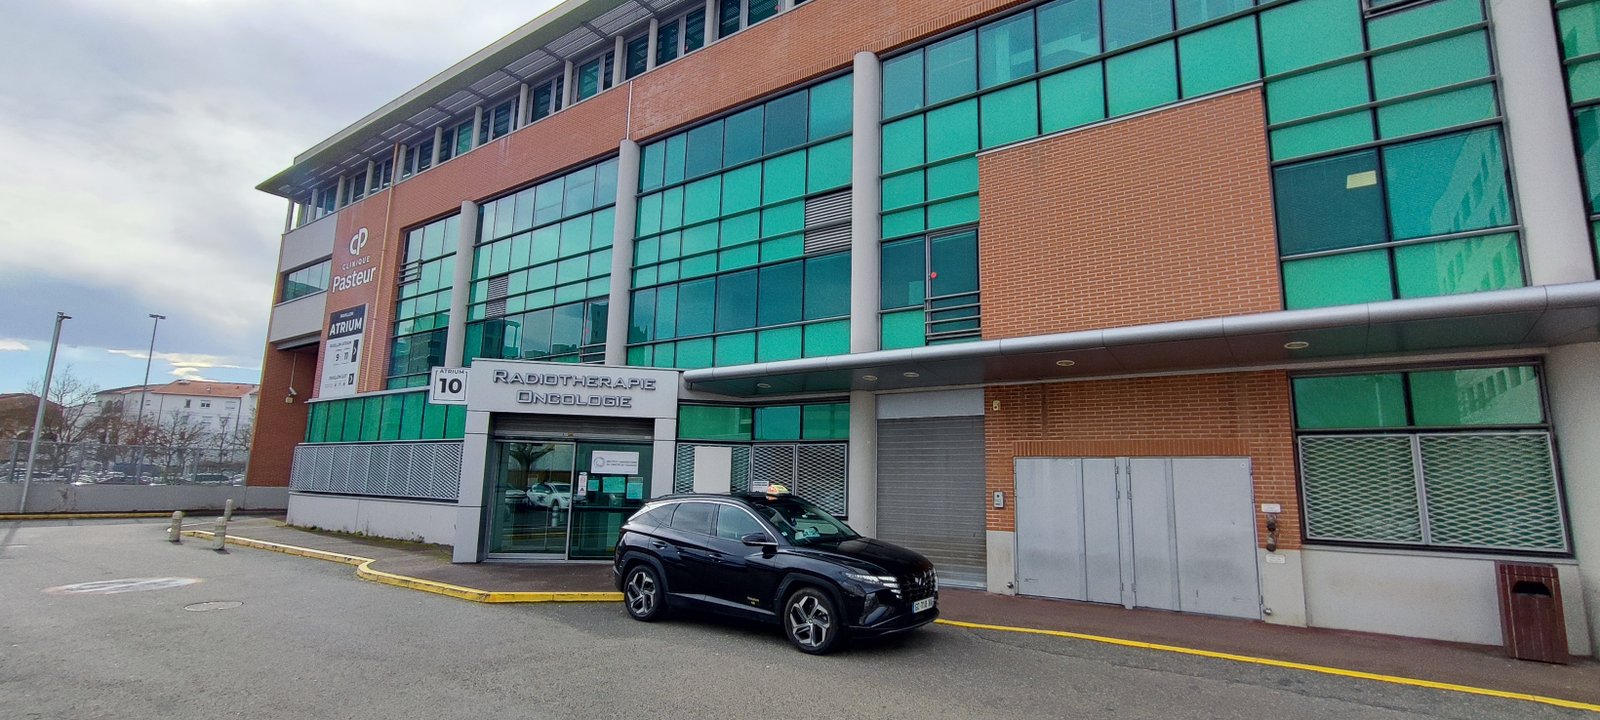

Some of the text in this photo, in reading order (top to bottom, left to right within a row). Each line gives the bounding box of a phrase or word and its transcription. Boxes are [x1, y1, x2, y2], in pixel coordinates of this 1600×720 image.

[342, 256, 371, 270] CLINIQUE
[332, 267, 377, 293] Pasteur
[329, 318, 362, 336] ATRIUM
[439, 378, 462, 394] 10
[493, 369, 657, 391] RADIOTHERAPIE
[517, 390, 632, 408] ONCOLOGIE
